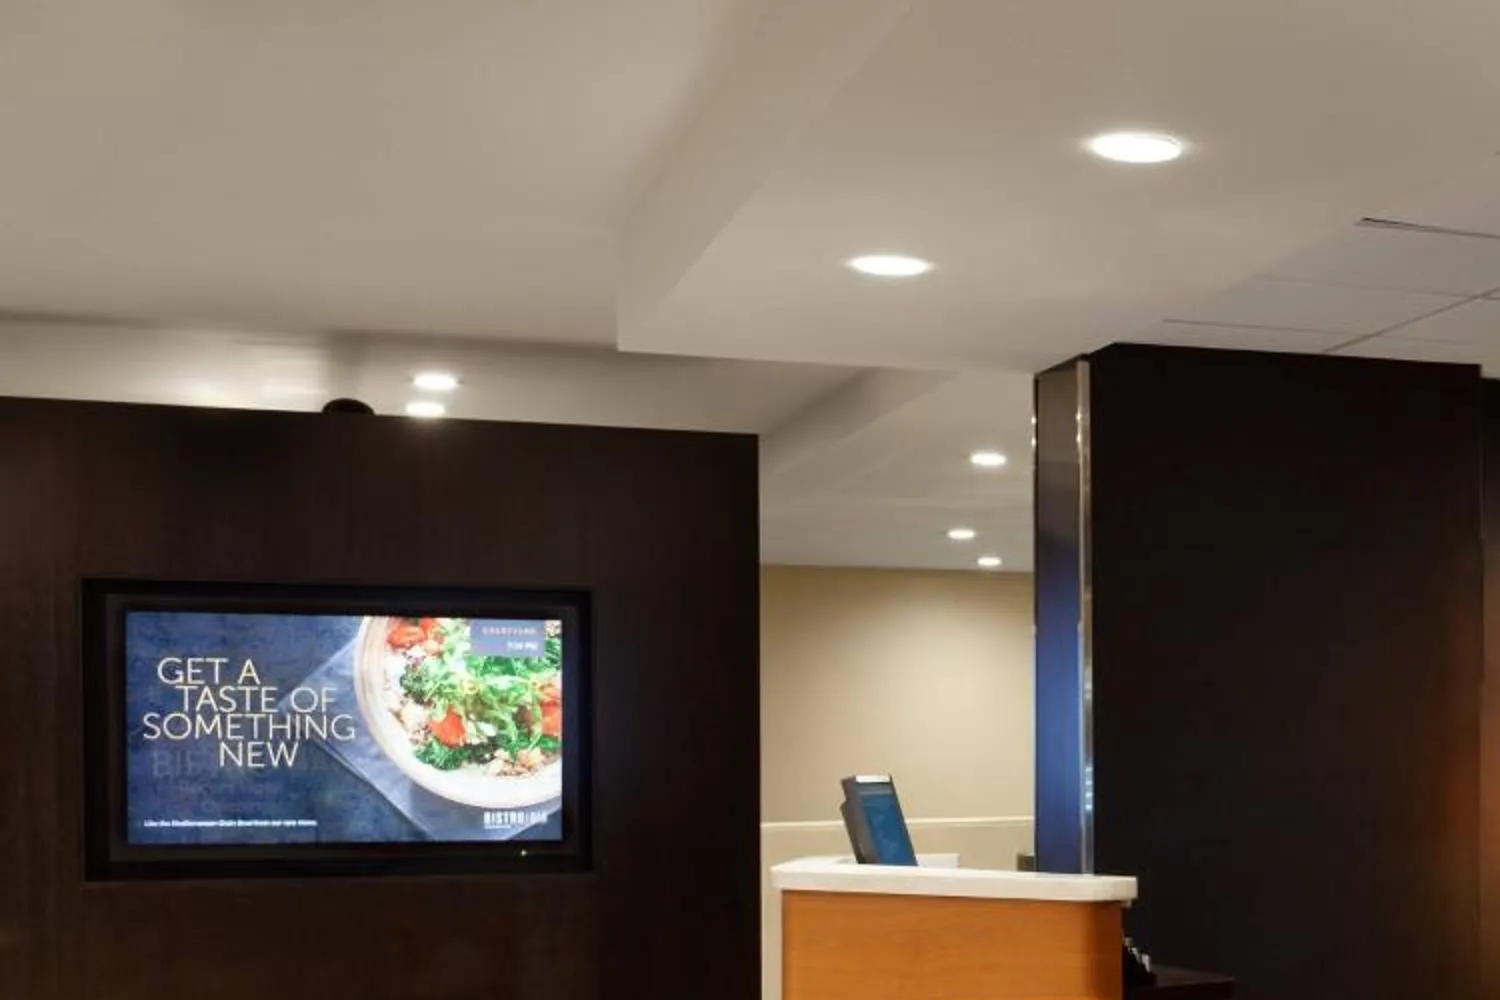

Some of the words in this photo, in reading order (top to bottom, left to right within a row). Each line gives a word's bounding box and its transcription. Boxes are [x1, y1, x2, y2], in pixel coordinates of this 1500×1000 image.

[157, 657, 229, 685] GET
[237, 658, 261, 685] A
[175, 686, 278, 713] TASTE
[290, 686, 337, 713] OF
[143, 713, 356, 741] SOMETHING
[219, 741, 299, 768] NEW
